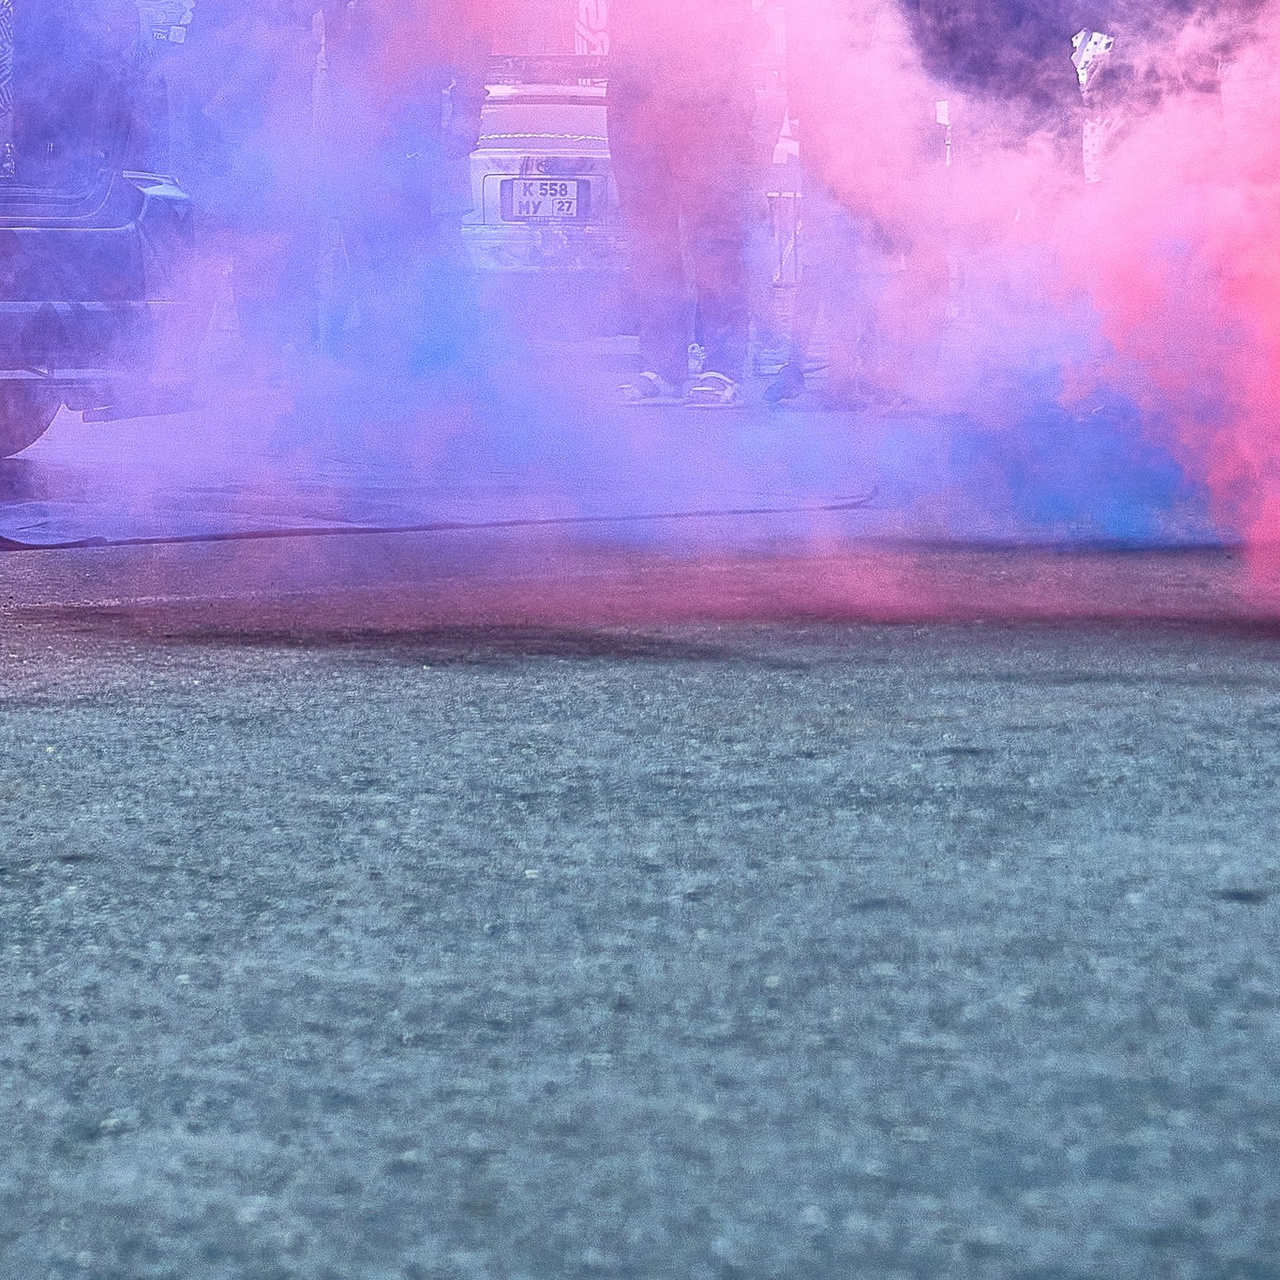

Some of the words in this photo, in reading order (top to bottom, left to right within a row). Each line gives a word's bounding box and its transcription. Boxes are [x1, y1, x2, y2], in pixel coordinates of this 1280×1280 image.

[523, 182, 534, 197] К
[540, 182, 568, 198] 558
[557, 200, 573, 212] 27
